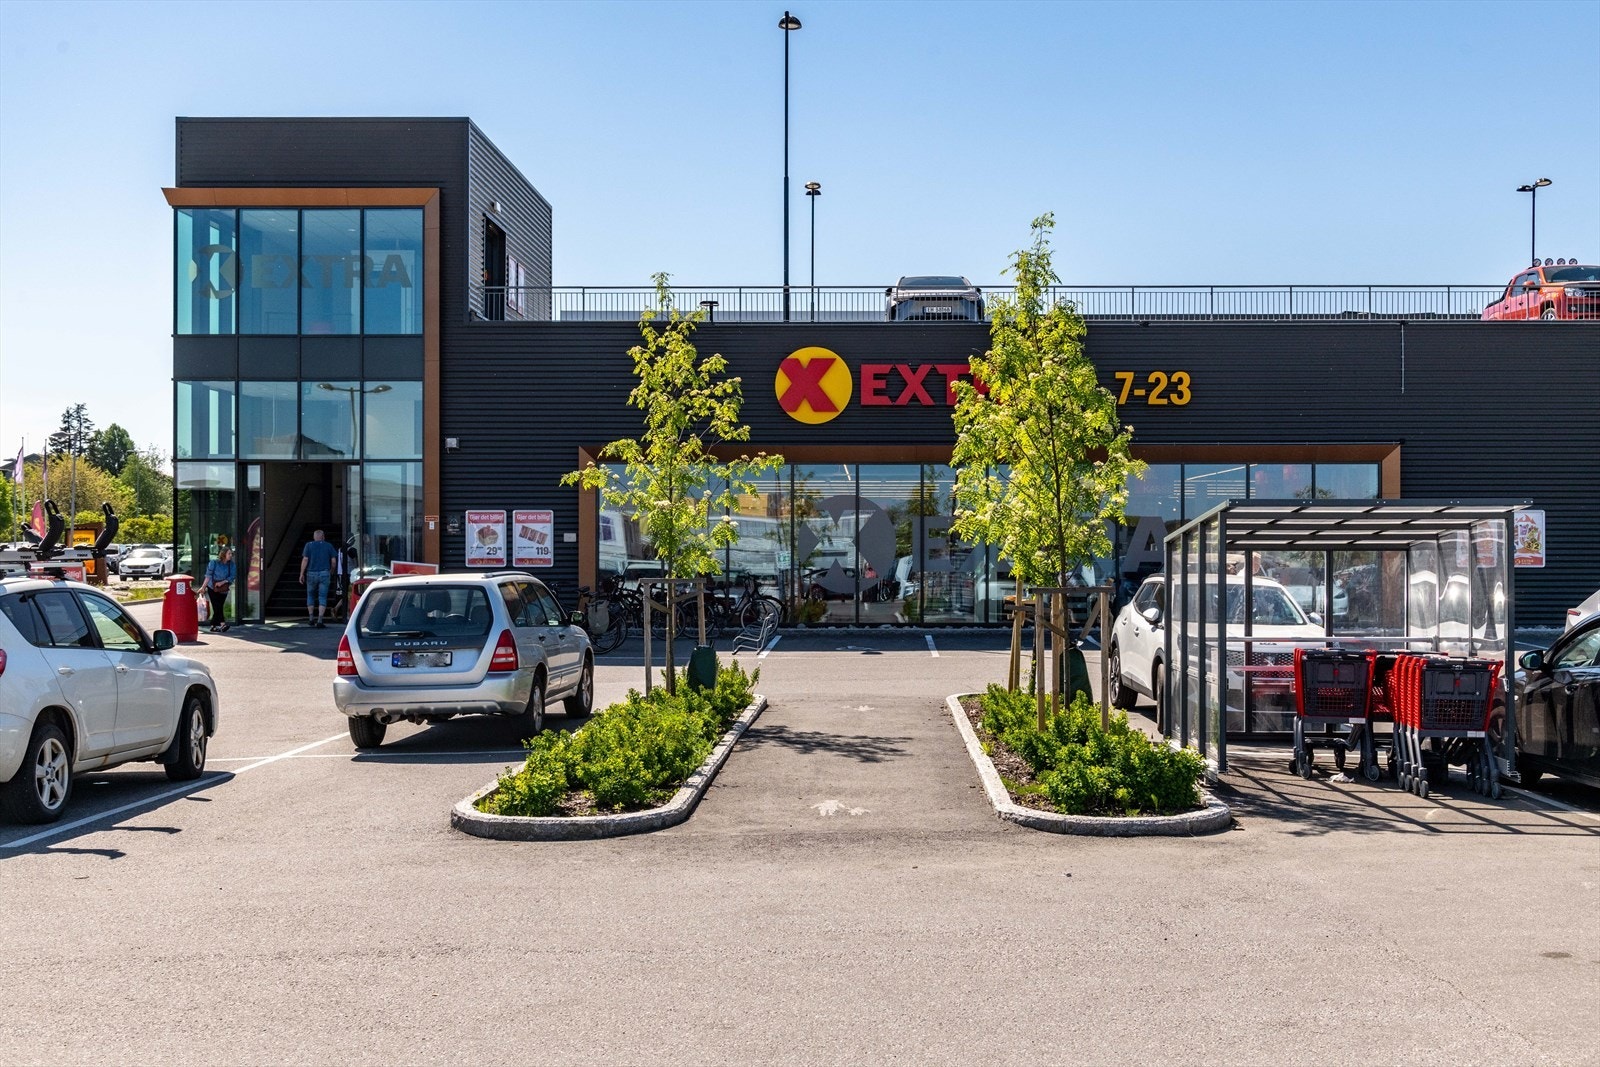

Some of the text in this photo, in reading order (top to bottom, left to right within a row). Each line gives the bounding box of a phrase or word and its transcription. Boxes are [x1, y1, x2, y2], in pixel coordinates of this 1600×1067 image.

[251, 254, 413, 289] EXTRA
[860, 364, 1003, 406] EXT
[1115, 371, 1192, 406] 7-23
[486, 546, 498, 555] 29
